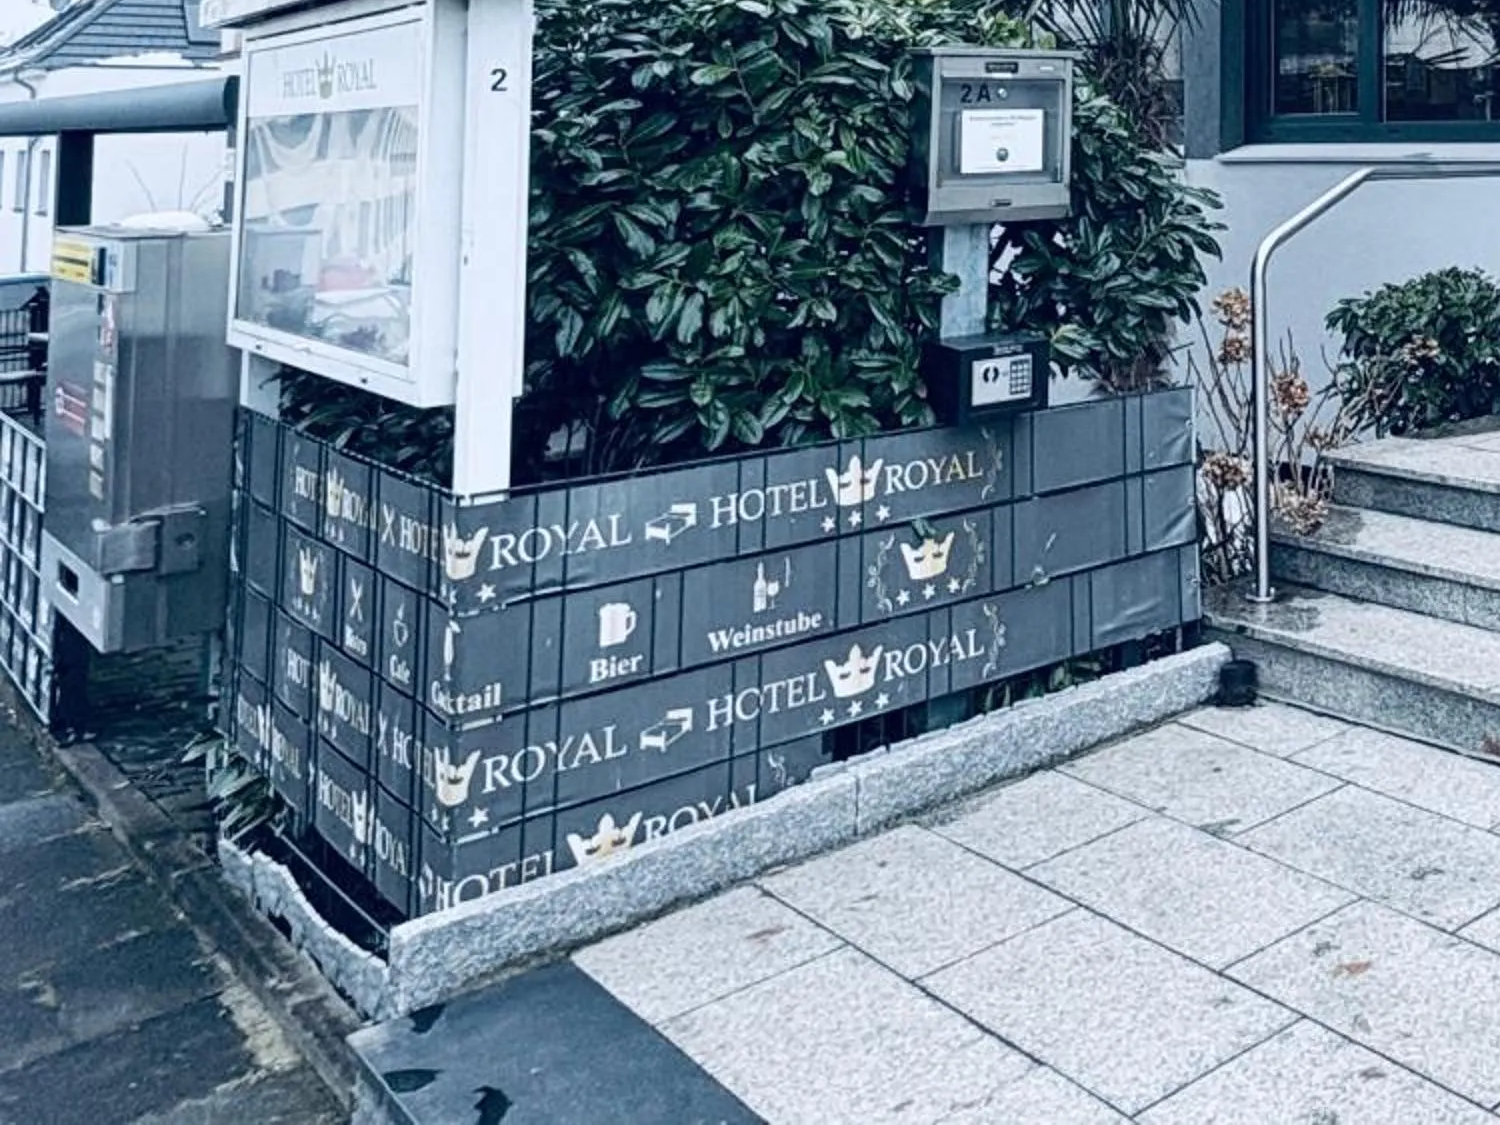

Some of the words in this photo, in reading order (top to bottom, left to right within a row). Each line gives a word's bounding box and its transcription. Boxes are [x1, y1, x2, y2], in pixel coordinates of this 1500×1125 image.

[490, 68, 509, 92] 2
[399, 515, 447, 567] HOTE
[487, 517, 632, 572] ROYAL
[709, 479, 828, 529] HOTEL
[883, 450, 984, 496] ROYAL
[589, 652, 644, 684] Bier
[706, 609, 824, 654] Weinstube
[482, 723, 628, 795] ROYAL
[706, 673, 827, 733] HOTEL
[883, 627, 985, 683] ROYAL
